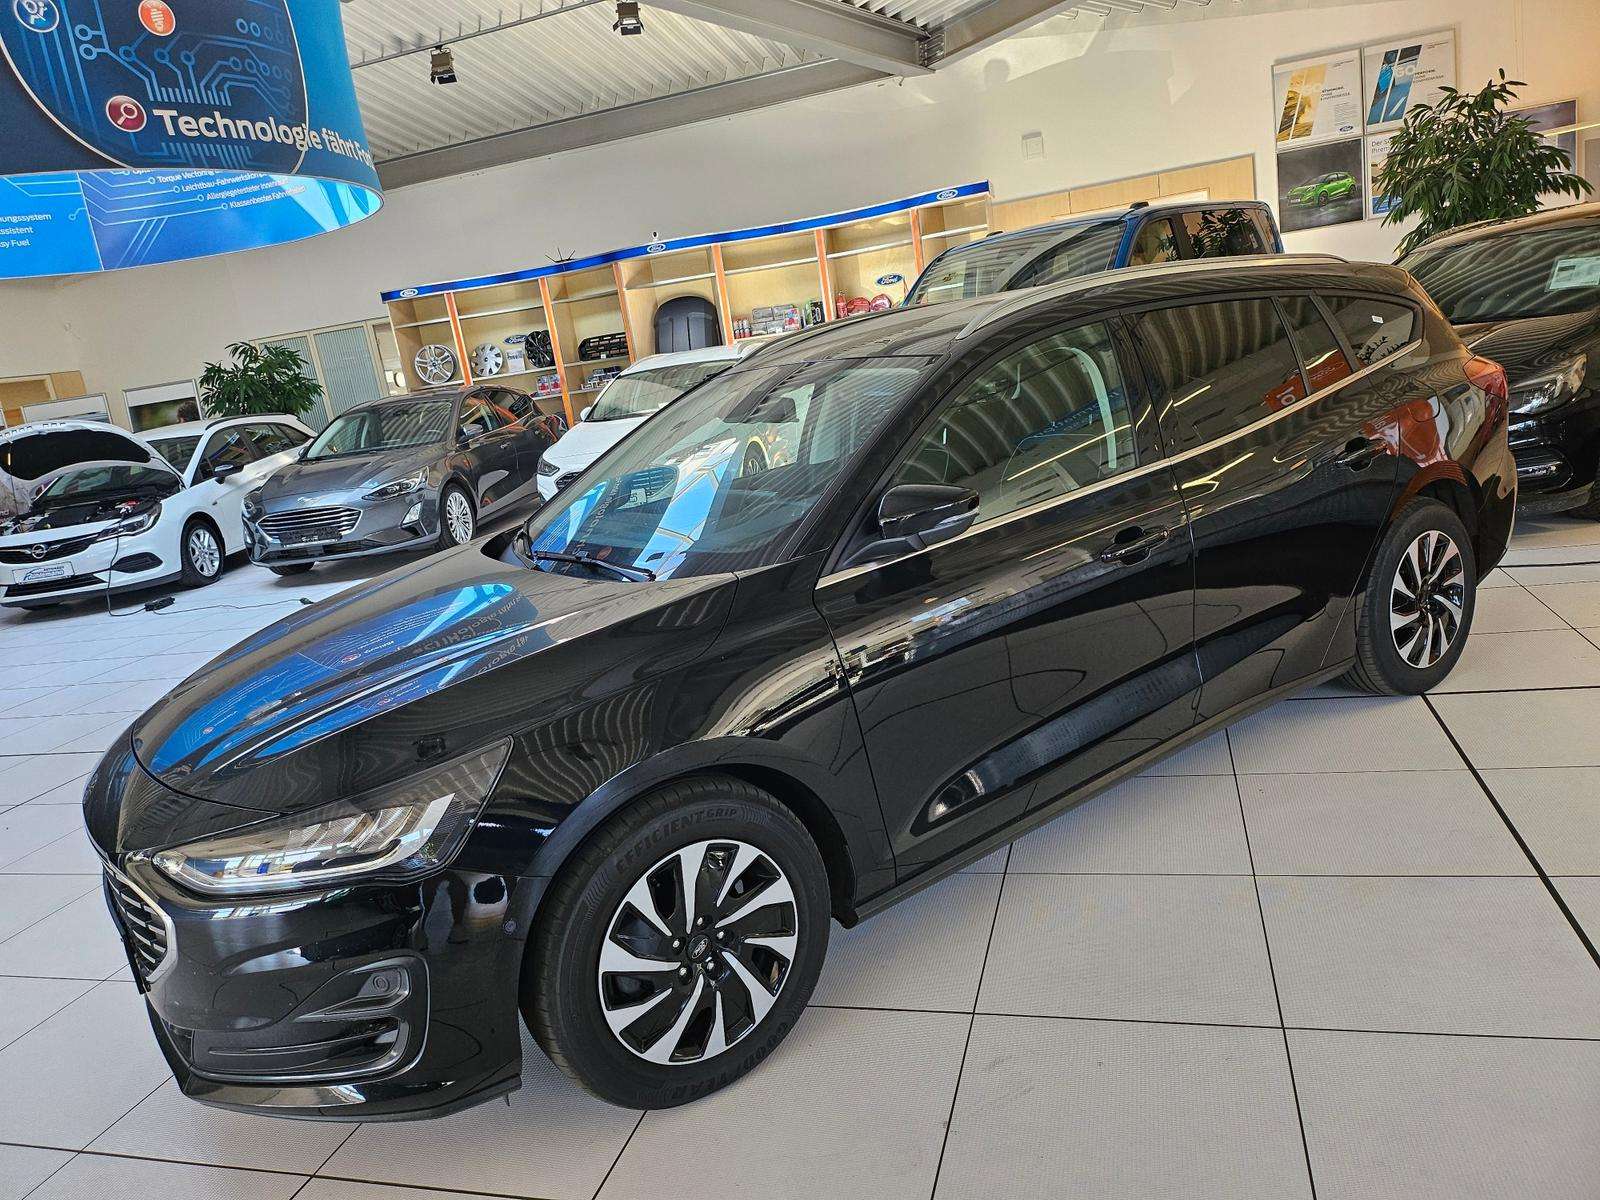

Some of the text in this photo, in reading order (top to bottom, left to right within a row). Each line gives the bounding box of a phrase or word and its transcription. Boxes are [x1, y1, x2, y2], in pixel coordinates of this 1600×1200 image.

[152, 108, 321, 151] Technologie
[320, 127, 359, 161] fährt
[507, 335, 527, 344] Ford
